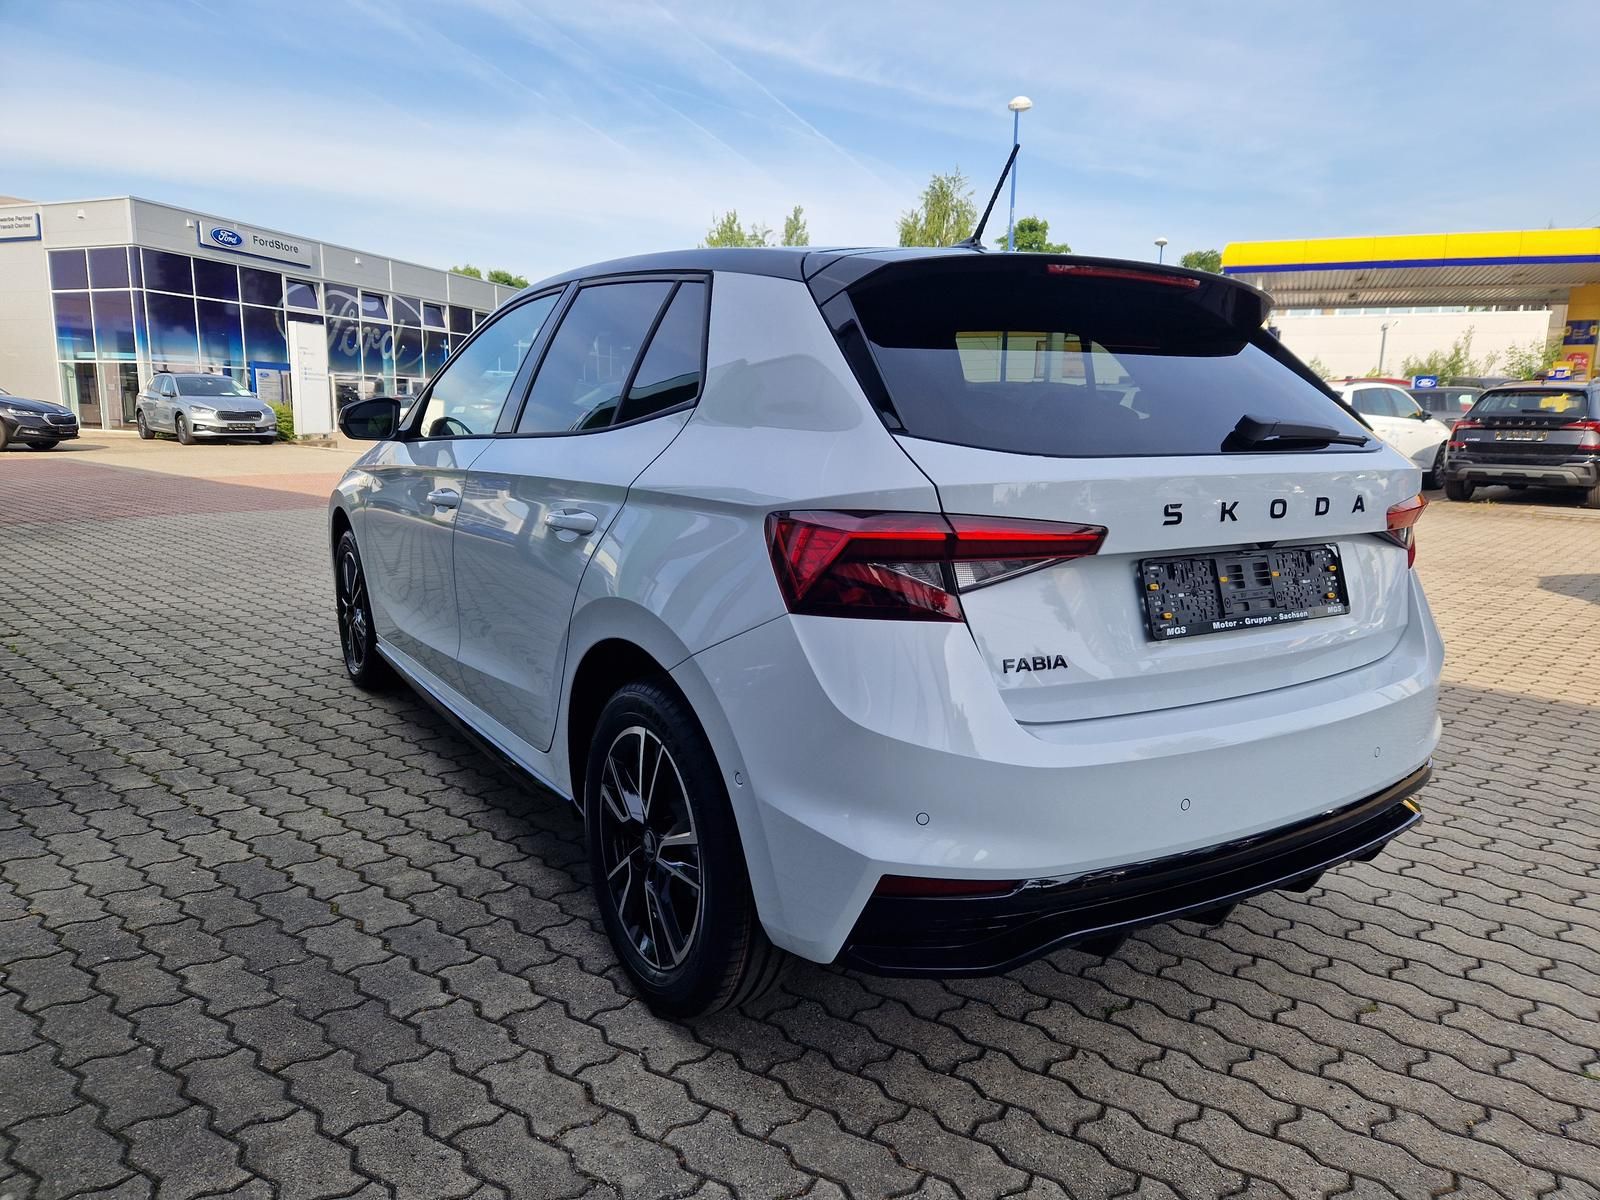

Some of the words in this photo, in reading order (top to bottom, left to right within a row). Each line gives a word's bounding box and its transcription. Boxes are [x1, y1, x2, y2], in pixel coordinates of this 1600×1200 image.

[252, 235, 299, 254] FordStore
[1162, 494, 1366, 526] SKODA
[1166, 626, 1187, 636] MGS
[1212, 619, 1237, 630] Motor
[1244, 615, 1273, 626] Gruppe
[1279, 610, 1309, 621] Sachsen
[1327, 604, 1342, 614] MGS
[1002, 654, 1069, 674] FABIA
